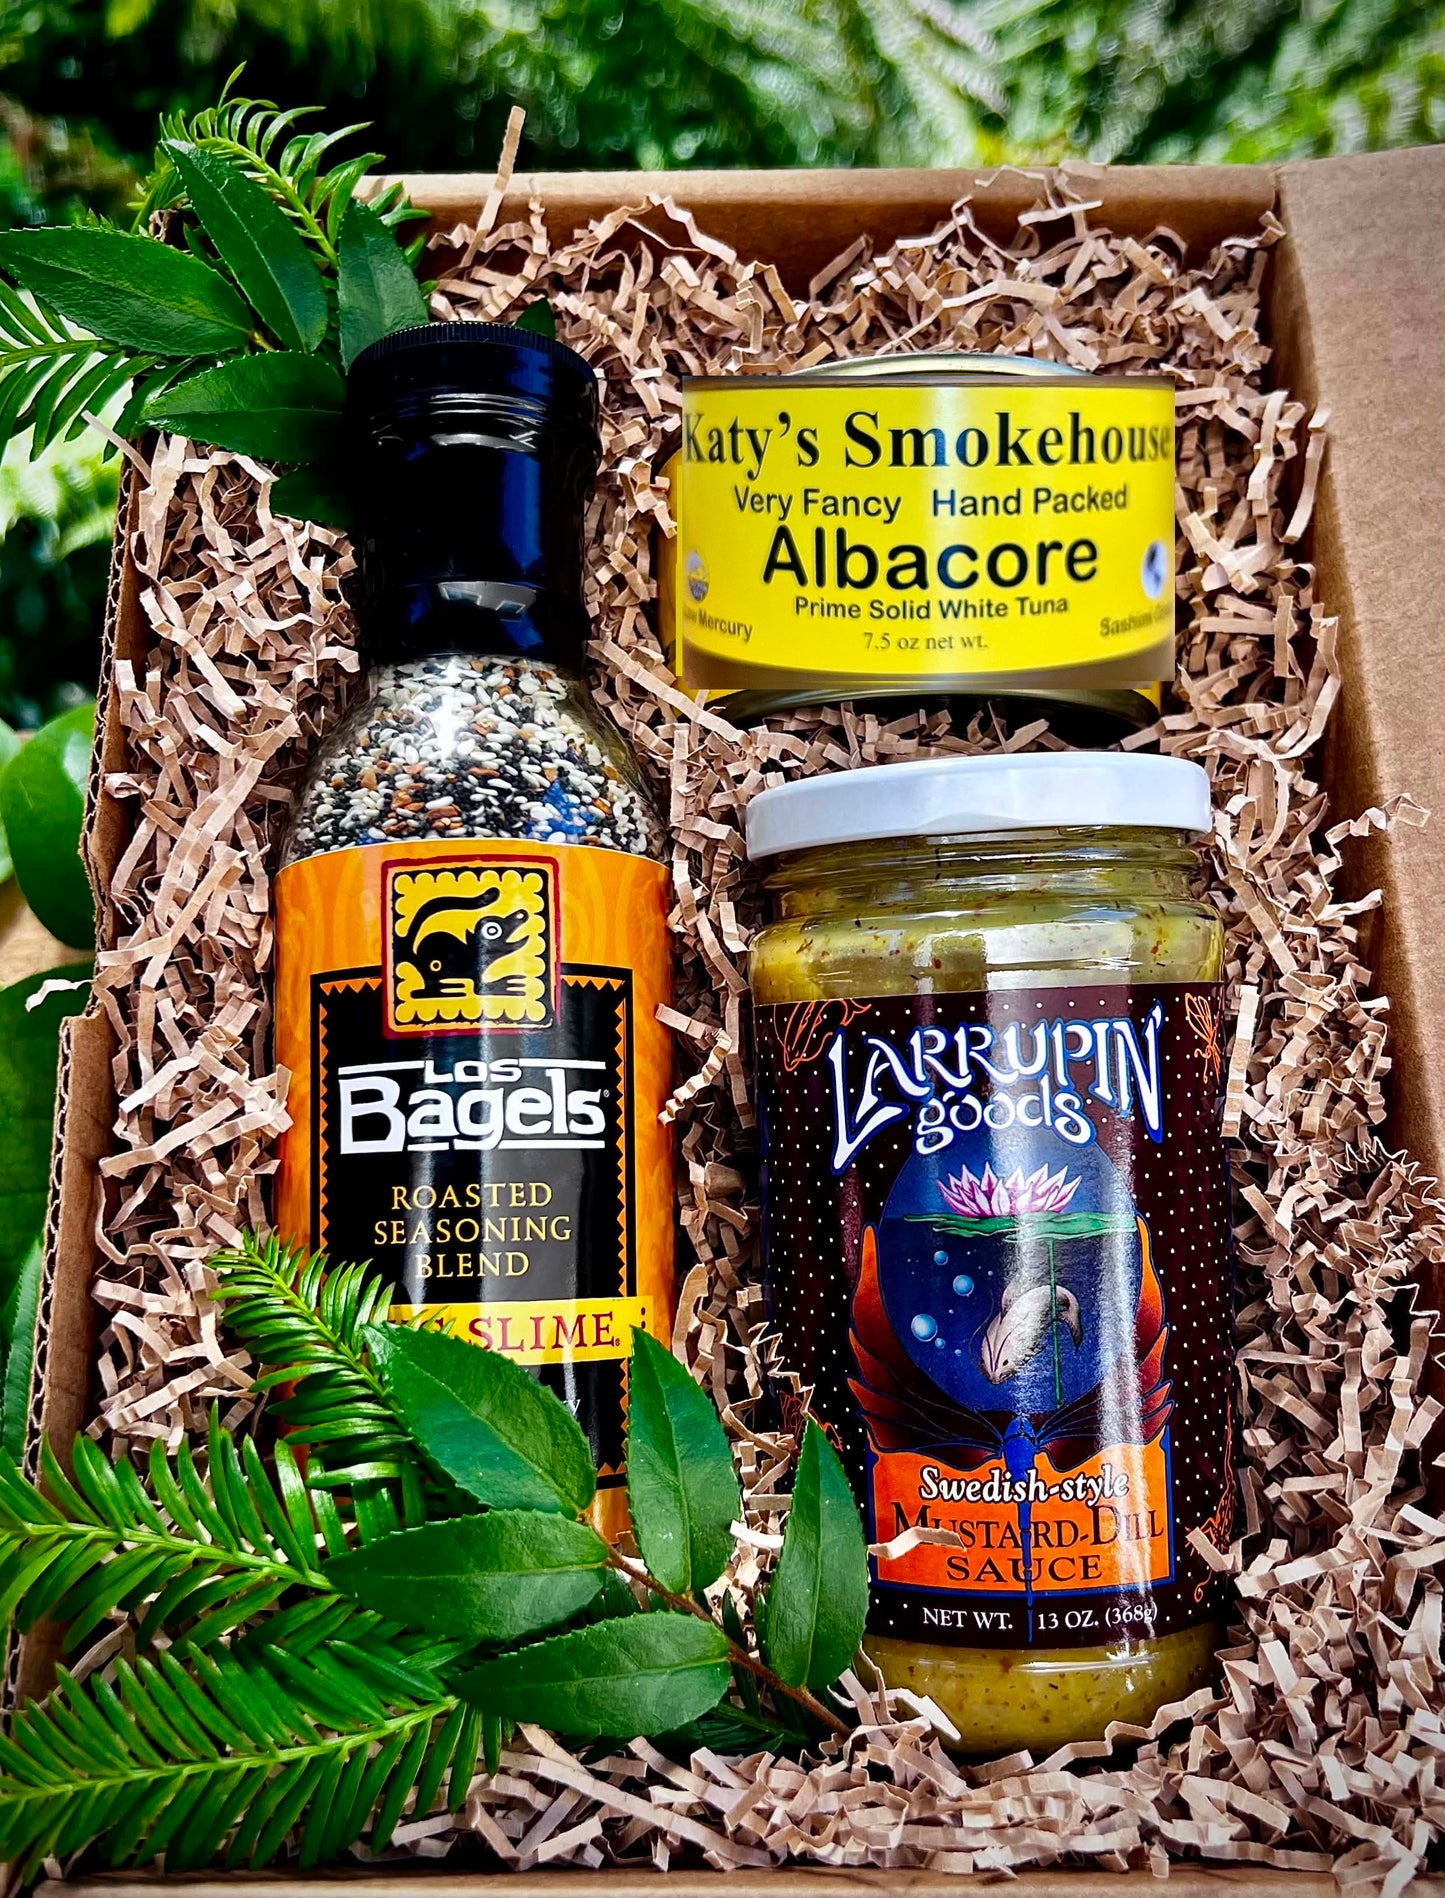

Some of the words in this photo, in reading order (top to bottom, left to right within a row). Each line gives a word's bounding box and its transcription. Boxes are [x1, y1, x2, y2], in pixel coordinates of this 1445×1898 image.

[684, 411, 820, 481] Katy's
[844, 410, 1170, 470] Smokehouse
[734, 485, 792, 521] Very
[803, 488, 901, 524] Fancy
[932, 487, 1021, 517] Hand
[1033, 484, 1128, 514] Packed
[763, 524, 1098, 590] Albacore
[795, 597, 861, 619] Prime
[869, 599, 931, 620] Solid
[939, 598, 1009, 620] White
[1016, 596, 1069, 616] Tuna
[863, 632, 891, 650] 7.5
[898, 635, 919, 650] oz
[925, 633, 955, 651] net
[960, 633, 989, 650] wt.
[338, 1068, 606, 1154] Bagels
[915, 1073, 1095, 1155] goods
[391, 1182, 553, 1210] ROASTED
[374, 1216, 572, 1245] SEASONING
[416, 1251, 530, 1279] BLEND
[920, 1463, 1129, 1506] Swedish-style
[946, 1554, 1103, 1583] SAUCE
[923, 1607, 967, 1628] NET
[973, 1611, 1013, 1630] WT.
[1037, 1612, 1059, 1630] 13
[1064, 1610, 1099, 1629] OZ.
[1104, 1603, 1159, 1629] (368g)
